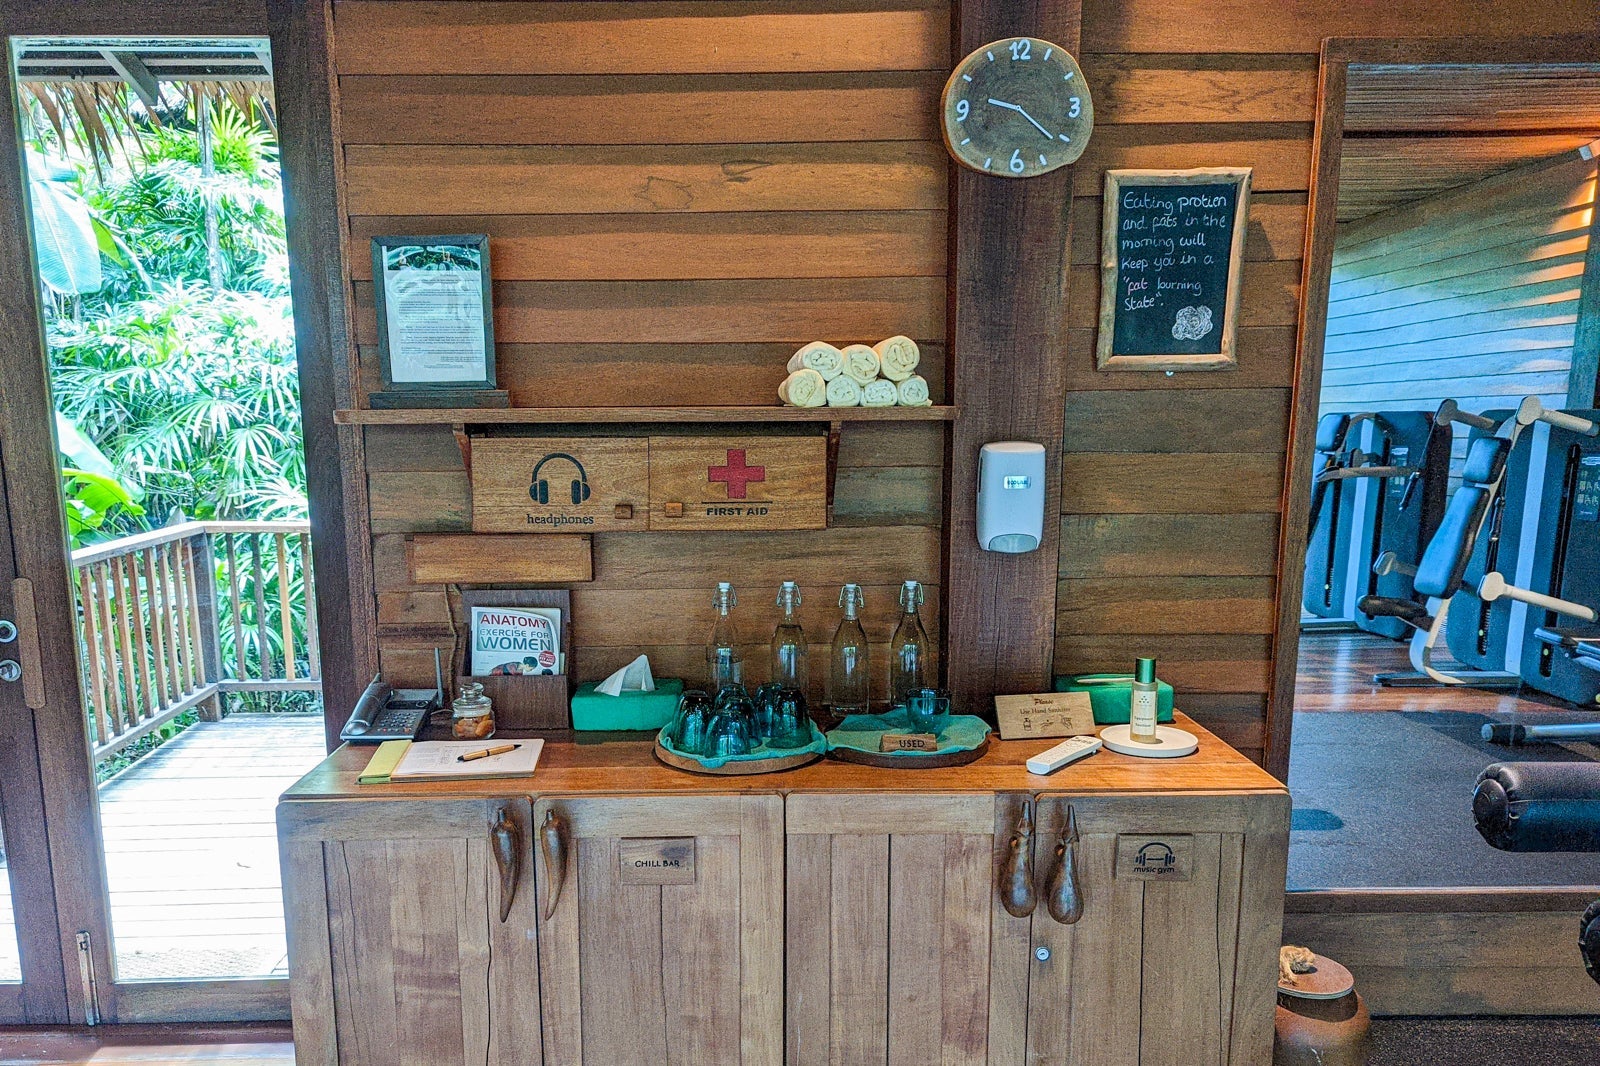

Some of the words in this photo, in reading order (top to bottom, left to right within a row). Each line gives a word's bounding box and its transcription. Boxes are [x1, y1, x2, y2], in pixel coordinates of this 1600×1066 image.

[1009, 39, 1031, 60] 12
[956, 100, 969, 121] 9
[1068, 97, 1080, 118] 3
[1009, 149, 1024, 173] 6
[1123, 192, 1173, 216] Eating
[1123, 216, 1147, 230] and
[1152, 216, 1177, 233] fats
[1185, 213, 1199, 226] in
[1203, 214, 1226, 228] the
[1122, 237, 1174, 255] morning
[1180, 233, 1206, 246] will
[1153, 257, 1175, 272] you
[1180, 251, 1196, 264] in
[1203, 255, 1214, 265] a
[1157, 277, 1202, 296] burning
[527, 514, 594, 527] headphones
[706, 507, 742, 516] FIRST
[747, 507, 769, 516] AID
[480, 614, 547, 628] ANATOMY
[480, 628, 527, 638] EXERCISE
[531, 631, 549, 639] FOR
[480, 637, 551, 650] WOMEN
[899, 740, 925, 748] USED
[663, 860, 680, 868] BAR
